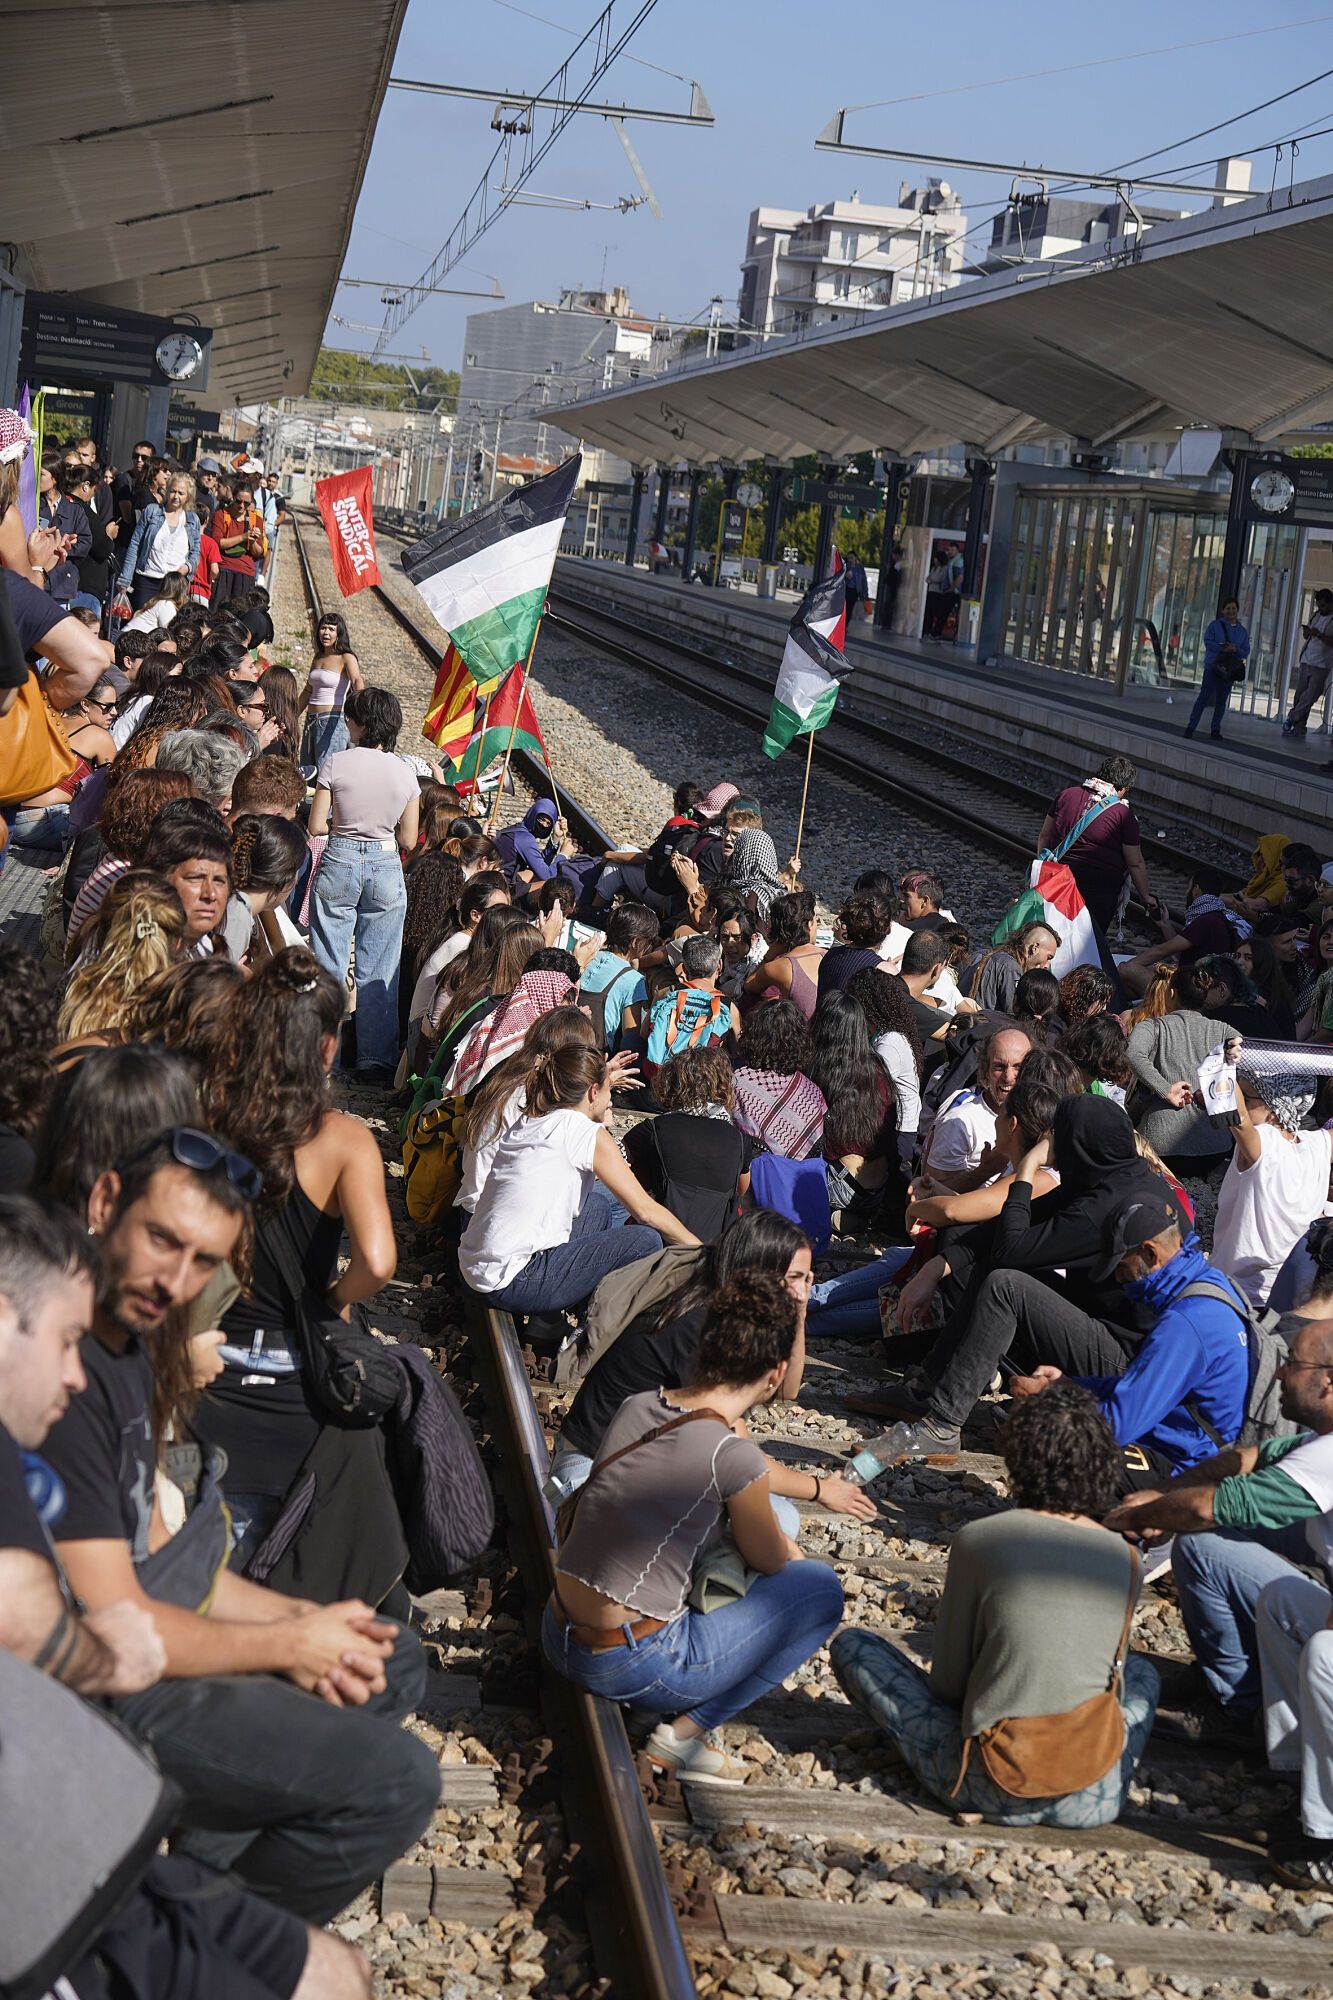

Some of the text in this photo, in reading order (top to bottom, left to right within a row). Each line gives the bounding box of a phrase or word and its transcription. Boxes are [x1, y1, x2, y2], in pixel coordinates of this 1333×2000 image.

[92, 319, 106, 327] Tren
[36, 333, 58, 342] Destino
[60, 335, 91, 346] Destinació
[56, 399, 84, 410] Girona
[827, 490, 855, 501] Girona
[344, 495, 370, 542] INTER
[332, 499, 369, 577] SINDICAL
